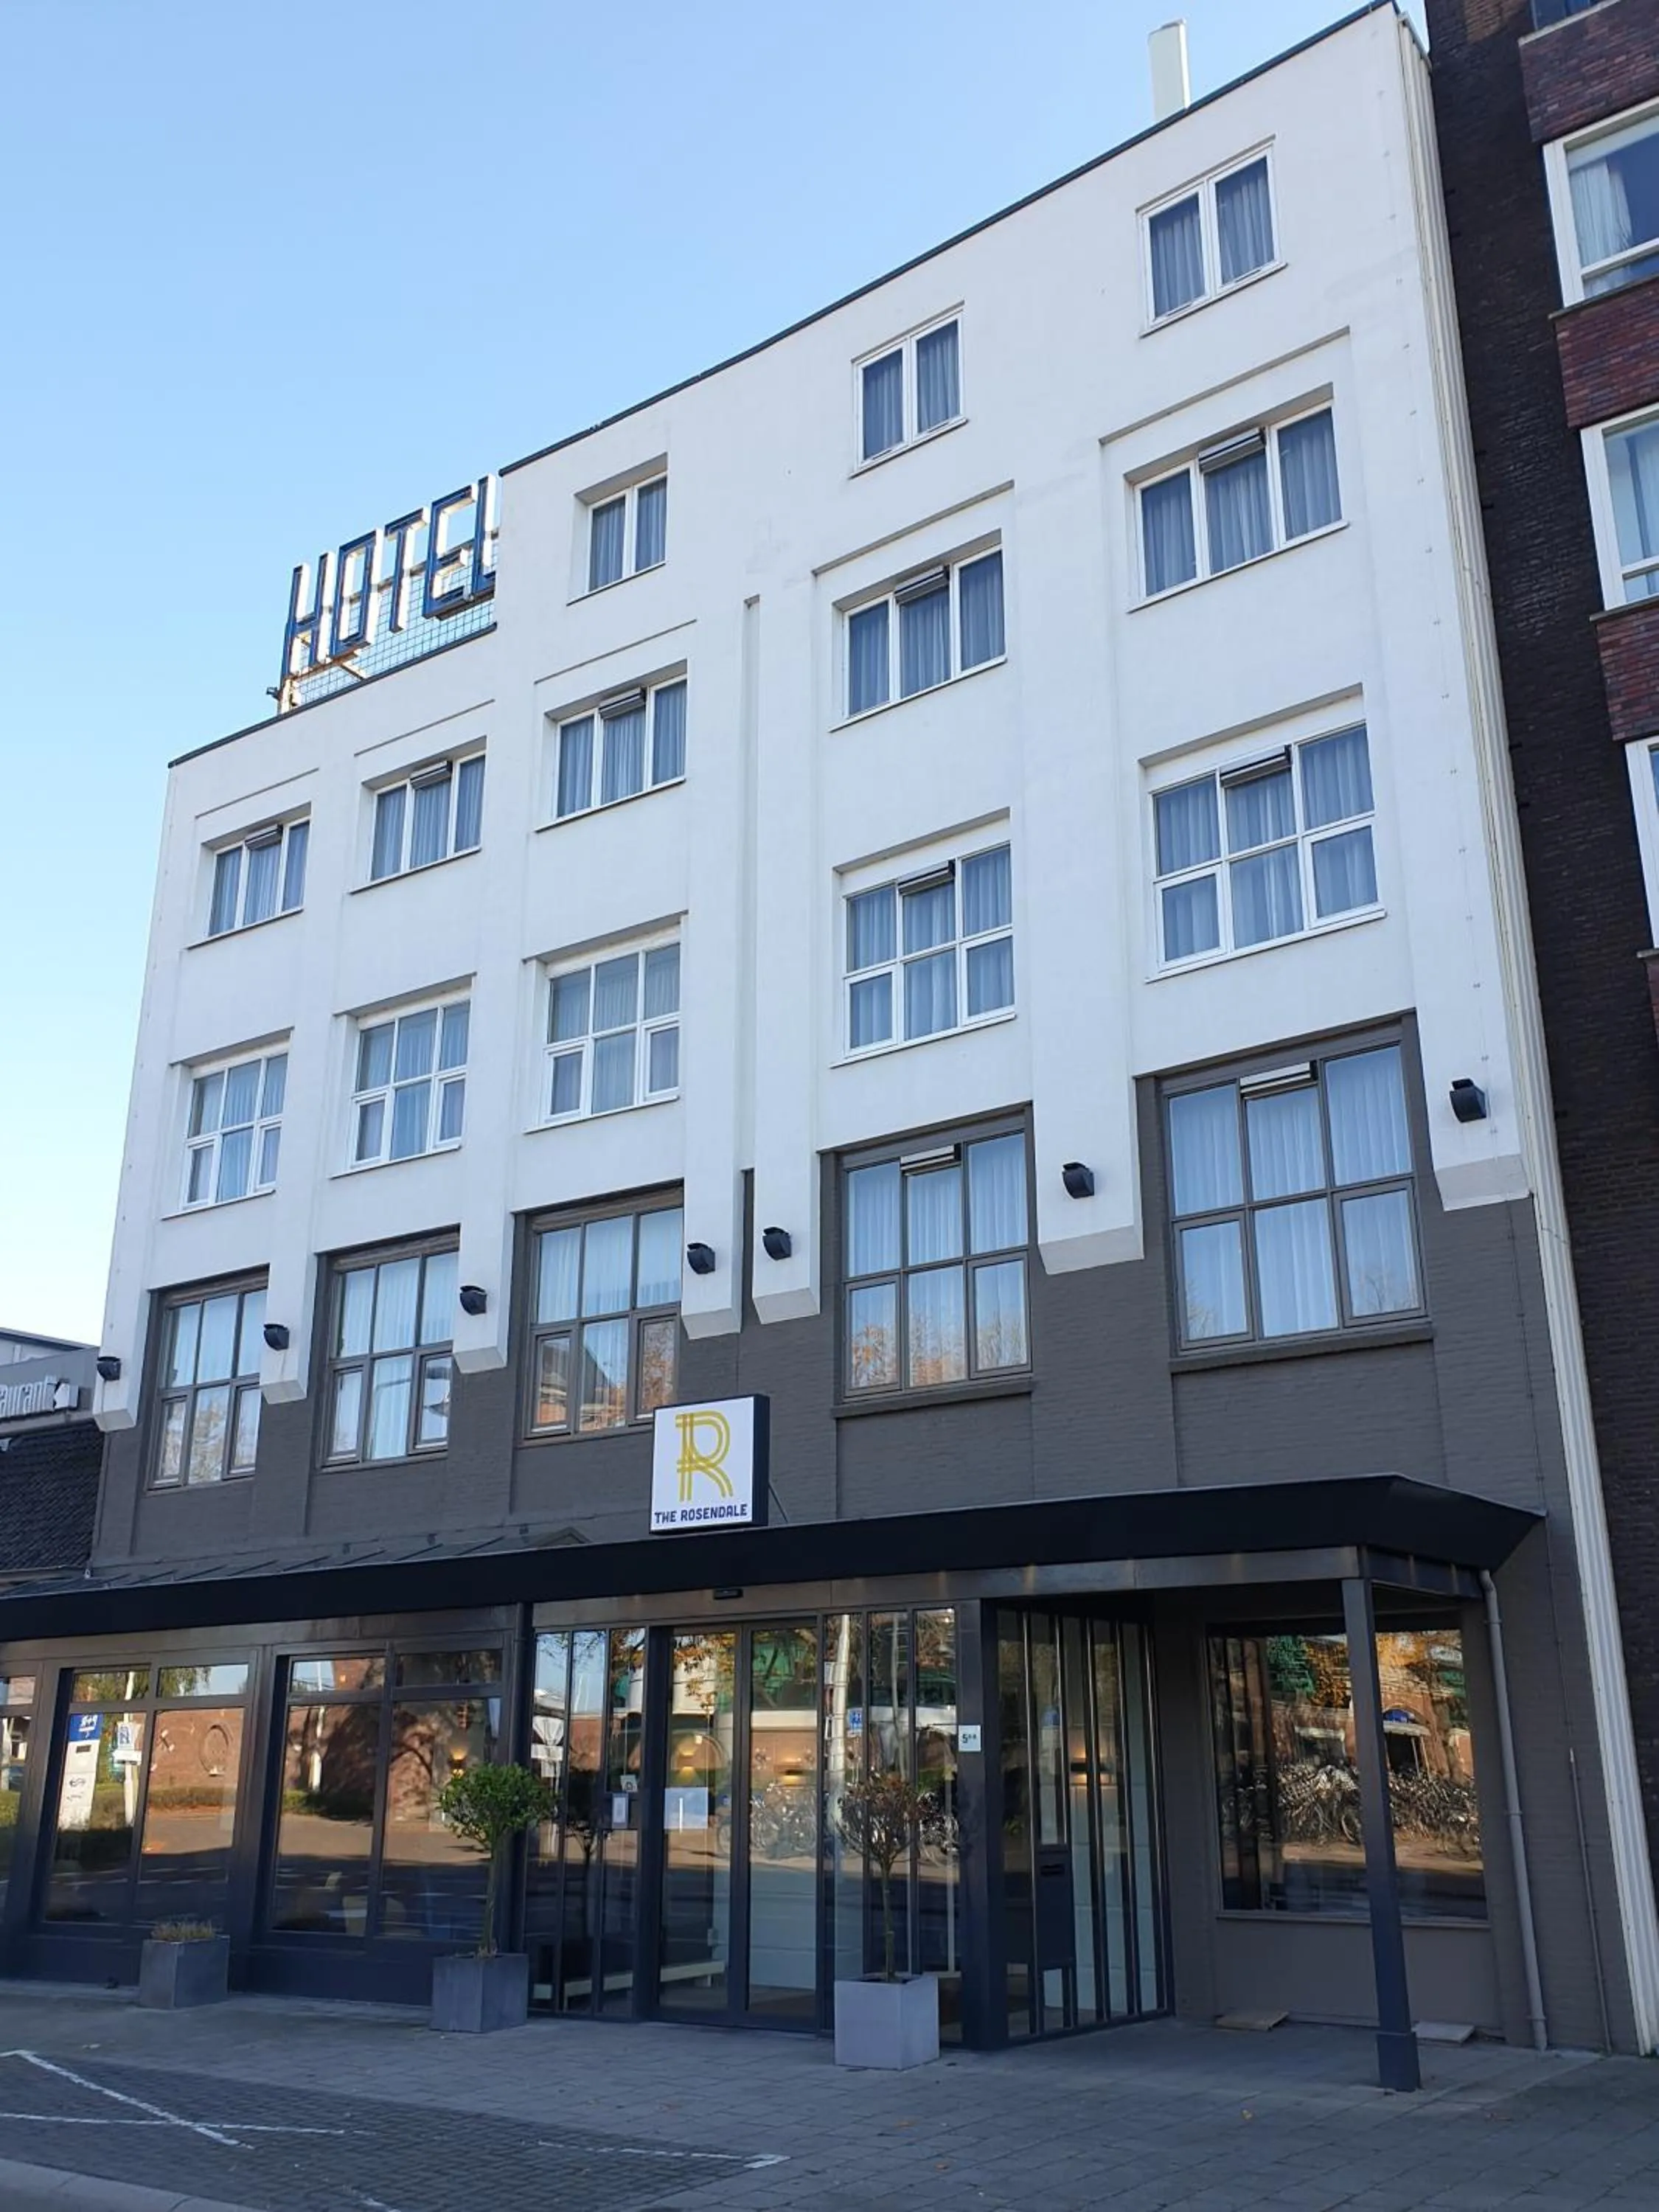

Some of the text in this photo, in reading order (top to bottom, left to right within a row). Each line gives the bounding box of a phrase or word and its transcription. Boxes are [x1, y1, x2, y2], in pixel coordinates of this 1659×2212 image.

[280, 474, 496, 681] HOTEL
[675, 1410, 734, 1502] R
[654, 1503, 748, 1524] THE ROSENDALE
